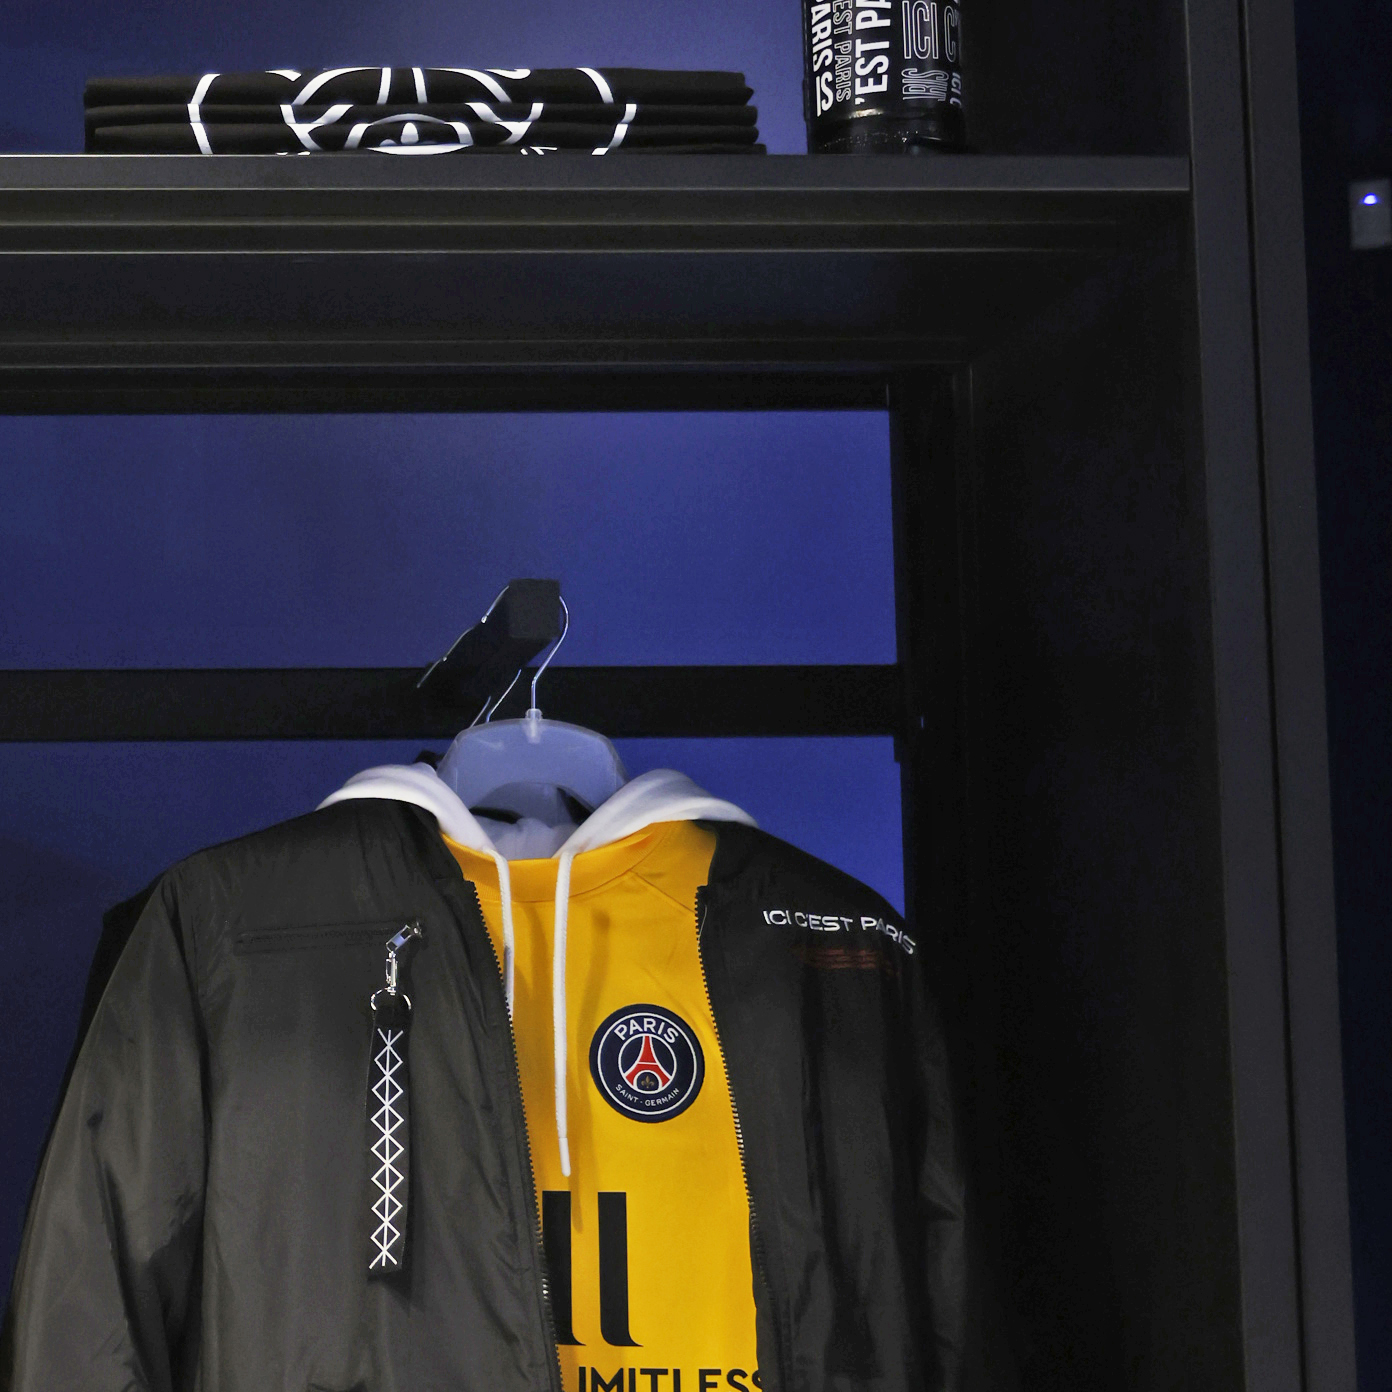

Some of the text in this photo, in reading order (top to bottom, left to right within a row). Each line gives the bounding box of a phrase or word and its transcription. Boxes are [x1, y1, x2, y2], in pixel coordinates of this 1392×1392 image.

[902, 0, 939, 59] ICI
[834, 39, 853, 103] PARIS
[762, 909, 792, 925] ICI
[860, 915, 917, 955] PARIS
[613, 1017, 679, 1044] PARIS
[615, 1083, 680, 1107] SAINT GERMAIN
